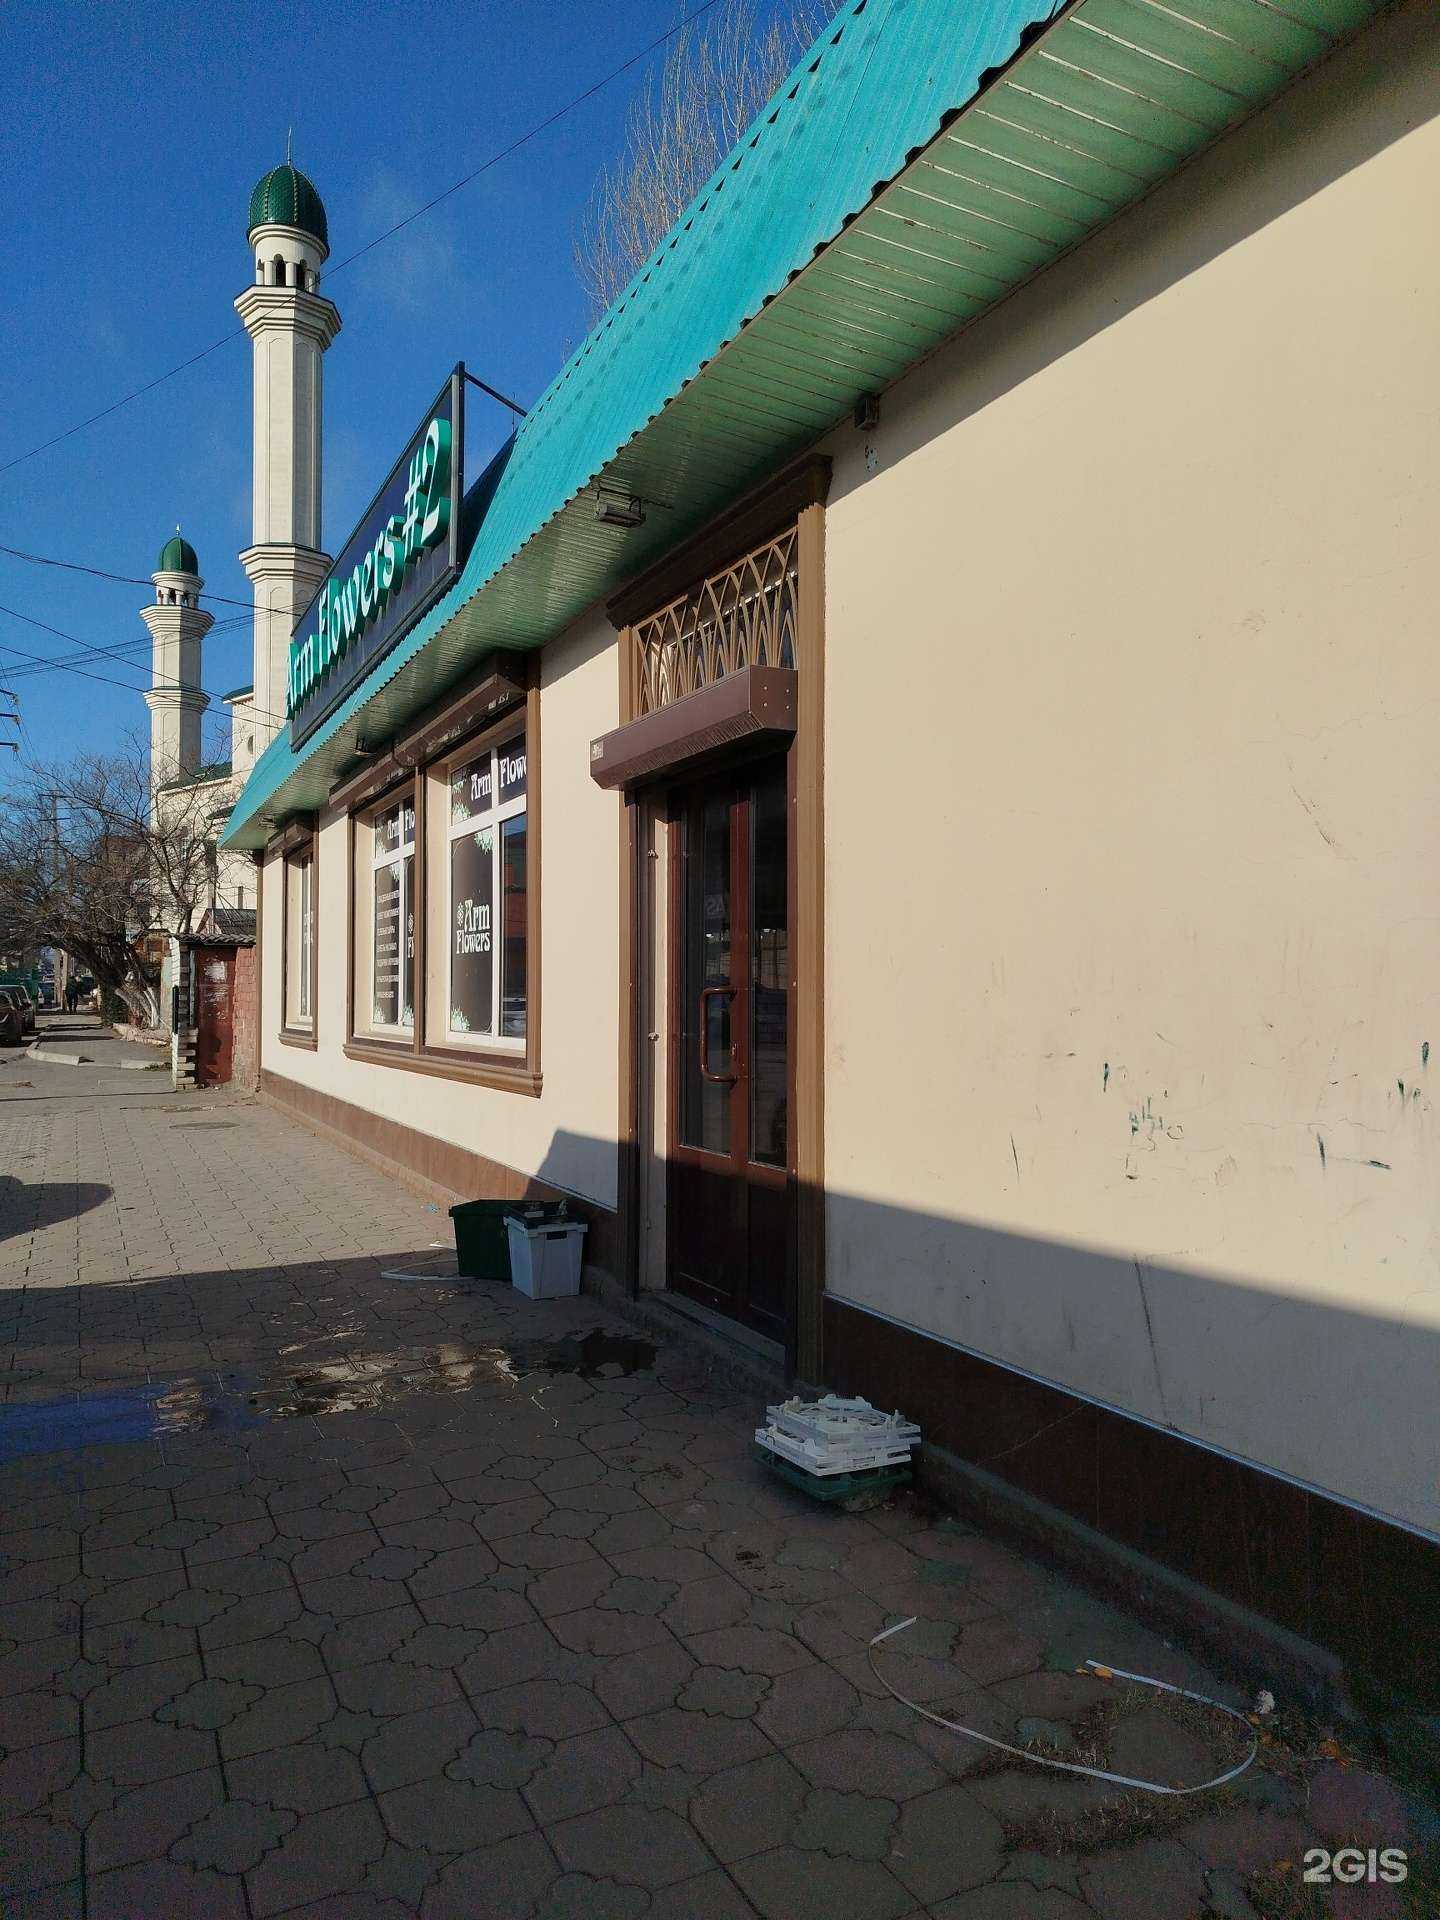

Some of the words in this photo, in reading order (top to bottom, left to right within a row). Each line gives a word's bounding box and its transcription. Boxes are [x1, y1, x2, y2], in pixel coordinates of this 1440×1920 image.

[286, 633, 328, 720] Arm
[318, 515, 405, 666] Flowers
[470, 773, 491, 801] Arm
[465, 899, 490, 933] Arm
[456, 929, 490, 954] Flowers
